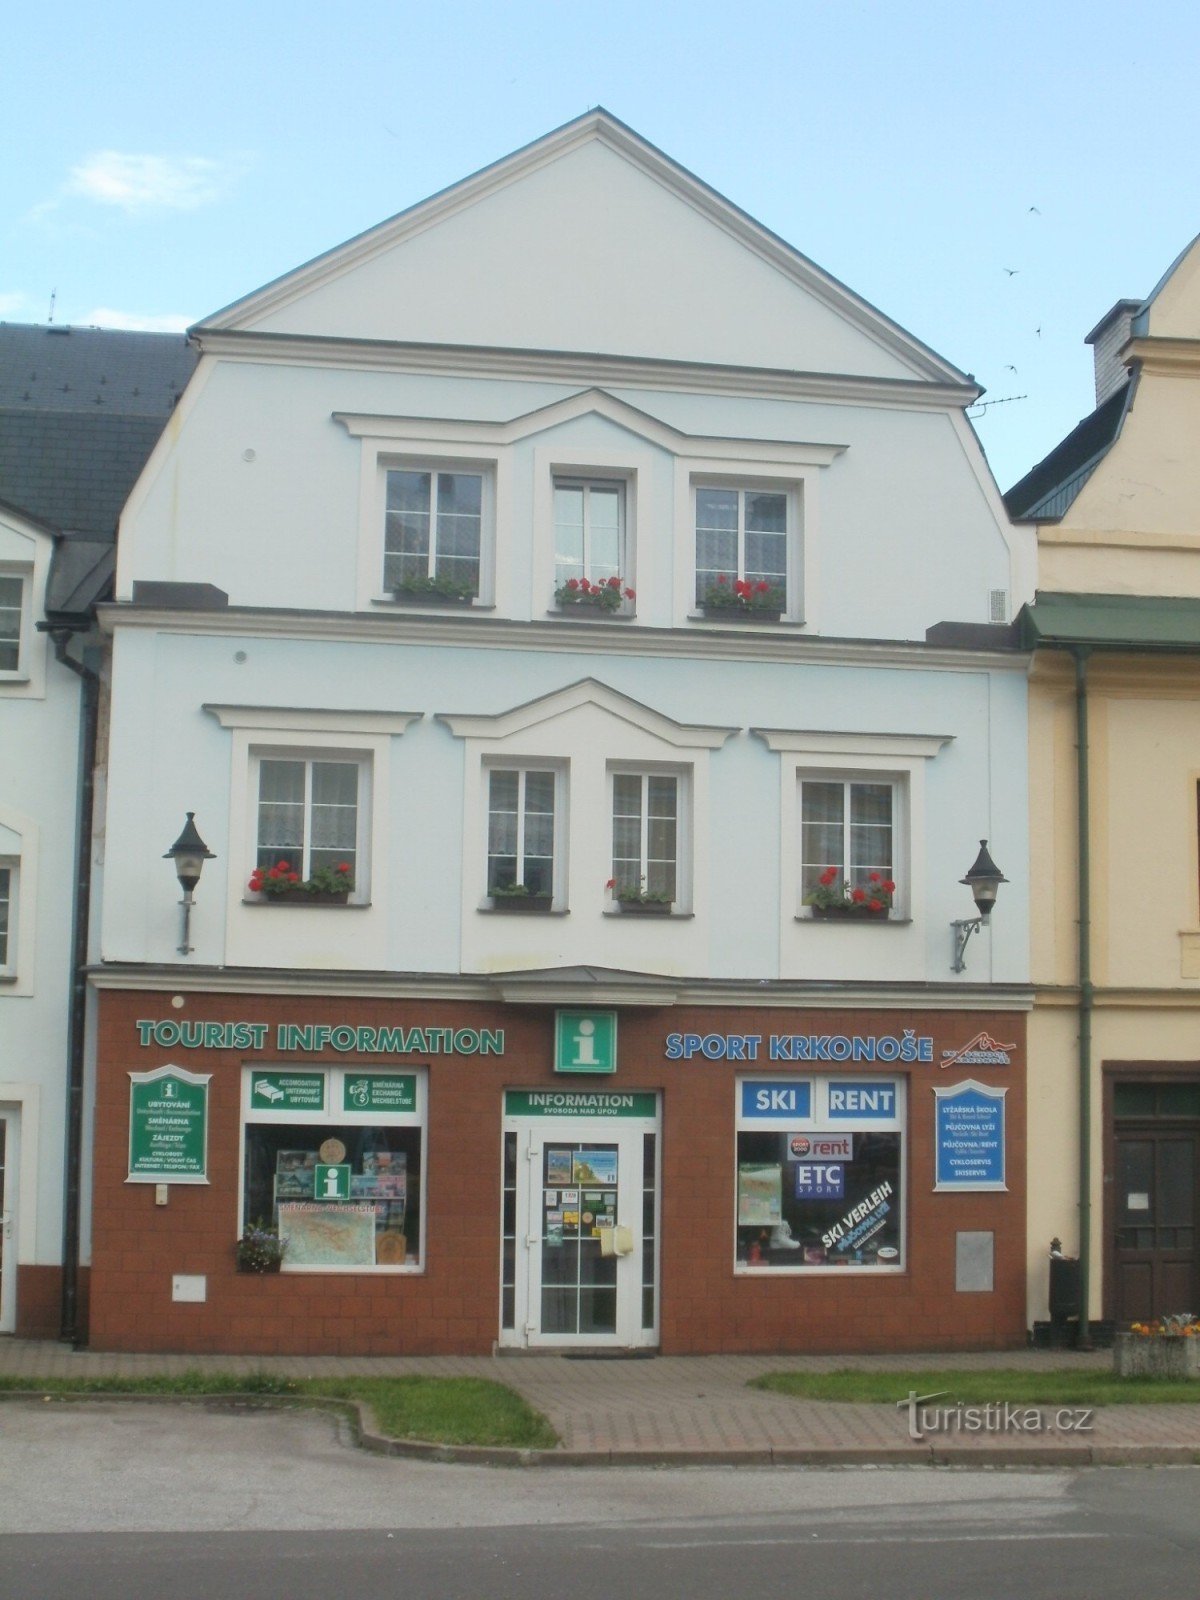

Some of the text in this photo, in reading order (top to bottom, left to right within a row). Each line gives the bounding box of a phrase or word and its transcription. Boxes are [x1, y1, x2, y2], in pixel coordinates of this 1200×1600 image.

[136, 1020, 505, 1055] TOURIST INFORMATION
[665, 1029, 934, 1062] SPORT KRKONOŠE
[148, 1101, 190, 1109] UBYTOVÁNÍ
[529, 1094, 634, 1107] INFORMATION
[756, 1089, 893, 1111] SKI RENT
[597, 1106, 618, 1115] ÚPOU
[943, 1105, 997, 1113] LYŽAŘSKÁ ŠKOLA
[148, 1117, 189, 1125] SMĚNÁRNA
[945, 1122, 980, 1131] PŮJČOVNA
[152, 1133, 184, 1141] ZÁJEZDY
[813, 1139, 849, 1155] rent
[799, 1165, 841, 1184] ETC
[821, 1223, 844, 1248] SKI
[842, 1181, 893, 1229] VERLEIH
